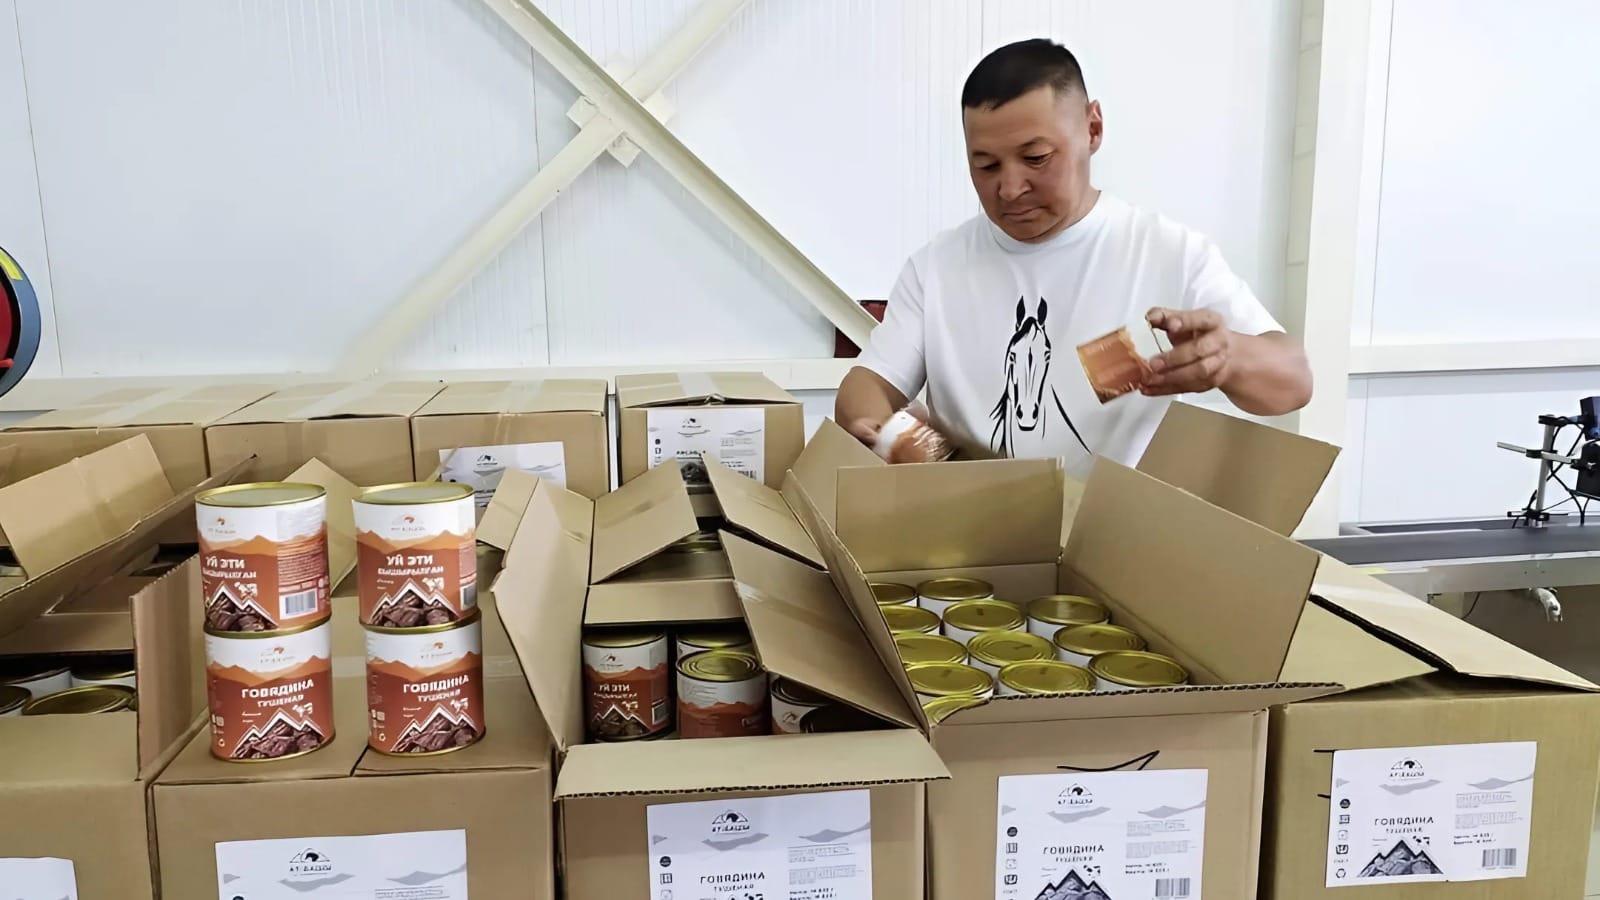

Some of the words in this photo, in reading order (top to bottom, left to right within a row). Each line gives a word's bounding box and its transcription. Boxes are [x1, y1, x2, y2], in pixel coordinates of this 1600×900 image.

[220, 558, 245, 569] ЭТИ
[386, 553, 404, 566] УЙ
[407, 554, 433, 566] ЭТИ
[241, 678, 314, 698] ГОВЯДИНА
[403, 674, 470, 693] ГОВЯДИНА
[1374, 815, 1435, 826] ГОВЯДИНА
[1043, 844, 1105, 856] ГОВЯДИНА
[699, 871, 766, 884] ГОВЯДИНА
